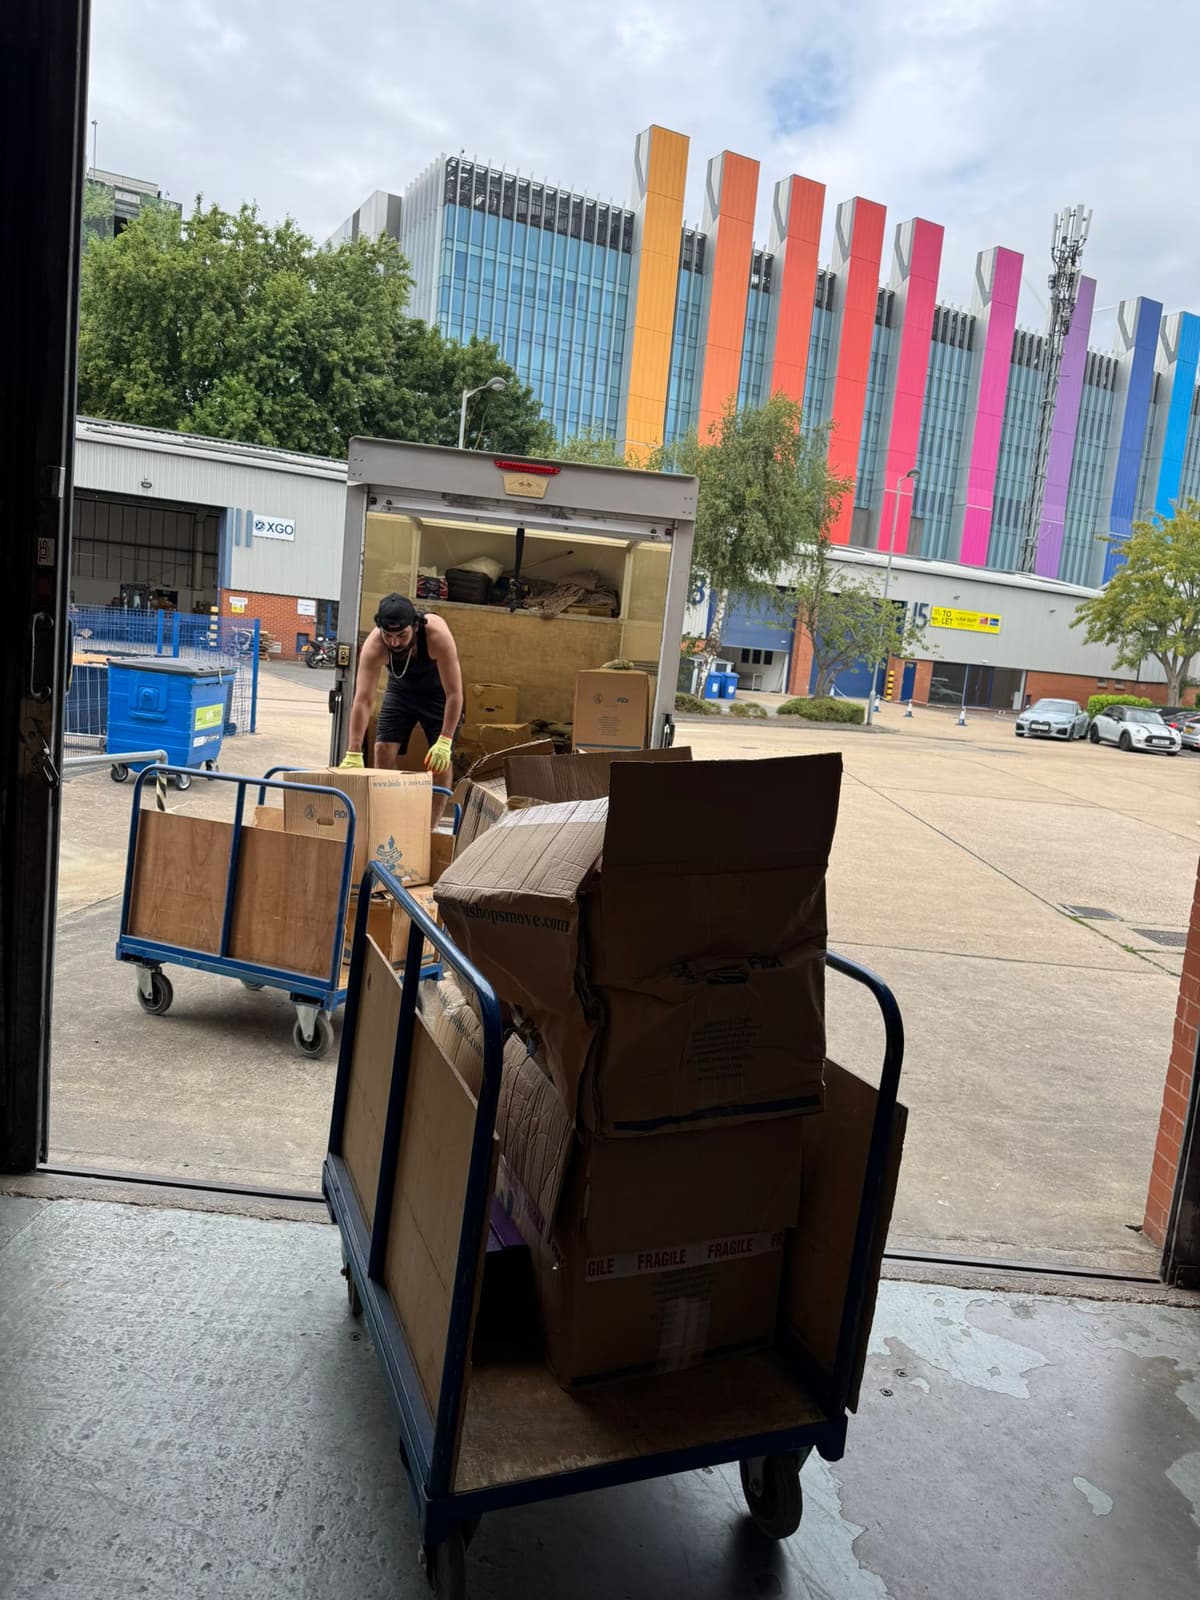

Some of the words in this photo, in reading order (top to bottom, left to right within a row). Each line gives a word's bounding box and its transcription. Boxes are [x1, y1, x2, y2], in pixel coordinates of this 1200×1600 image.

[266, 521, 294, 536] XGO
[943, 610, 952, 618] TO
[941, 617, 954, 625] LET
[638, 1248, 688, 1270] FRAGILE
[707, 1237, 754, 1259] FRAGILE
